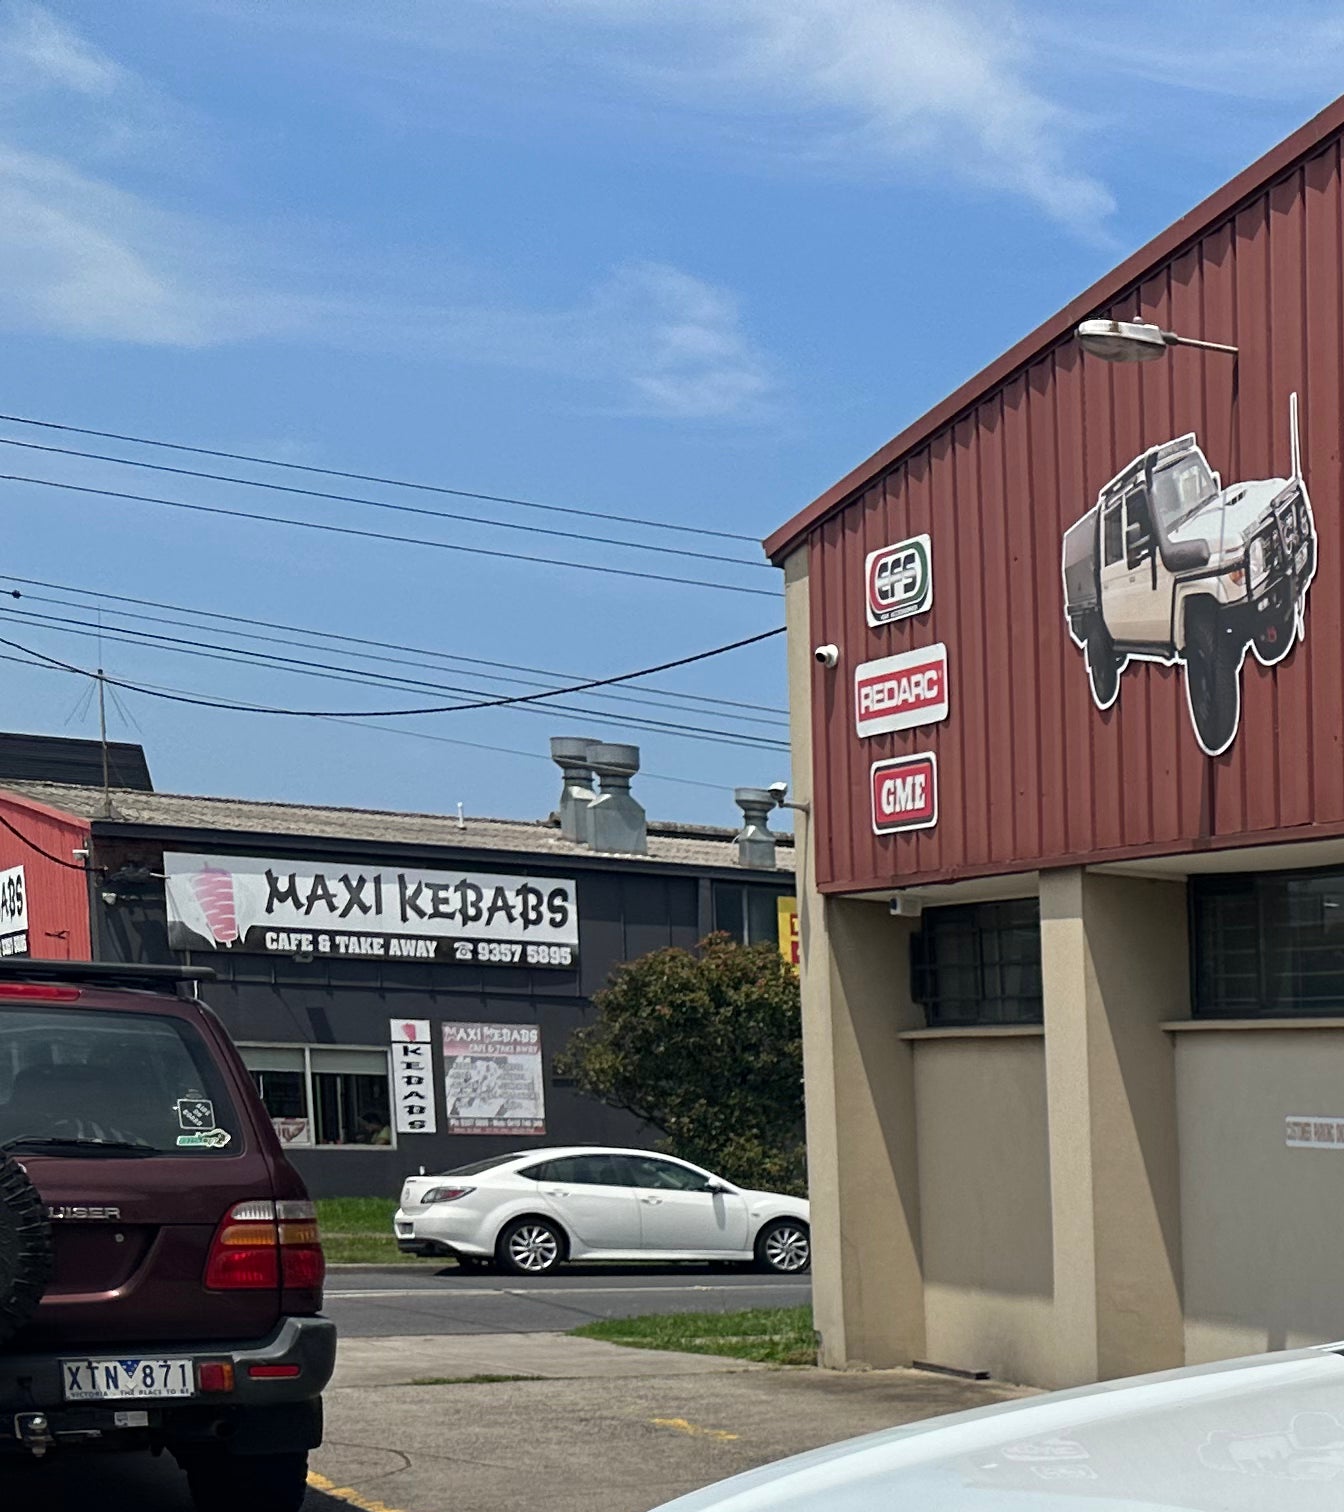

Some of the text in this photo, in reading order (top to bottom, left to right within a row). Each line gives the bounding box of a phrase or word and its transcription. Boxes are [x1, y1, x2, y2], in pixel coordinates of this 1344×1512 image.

[860, 669, 939, 715] REDARC
[880, 773, 926, 816] GME
[264, 868, 570, 931] MAXI KEBABS
[265, 932, 572, 966] CAFE & TAKE AWAY 9357 5895
[443, 1026, 481, 1042] MAXI
[67, 1364, 186, 1390] XTN 871
